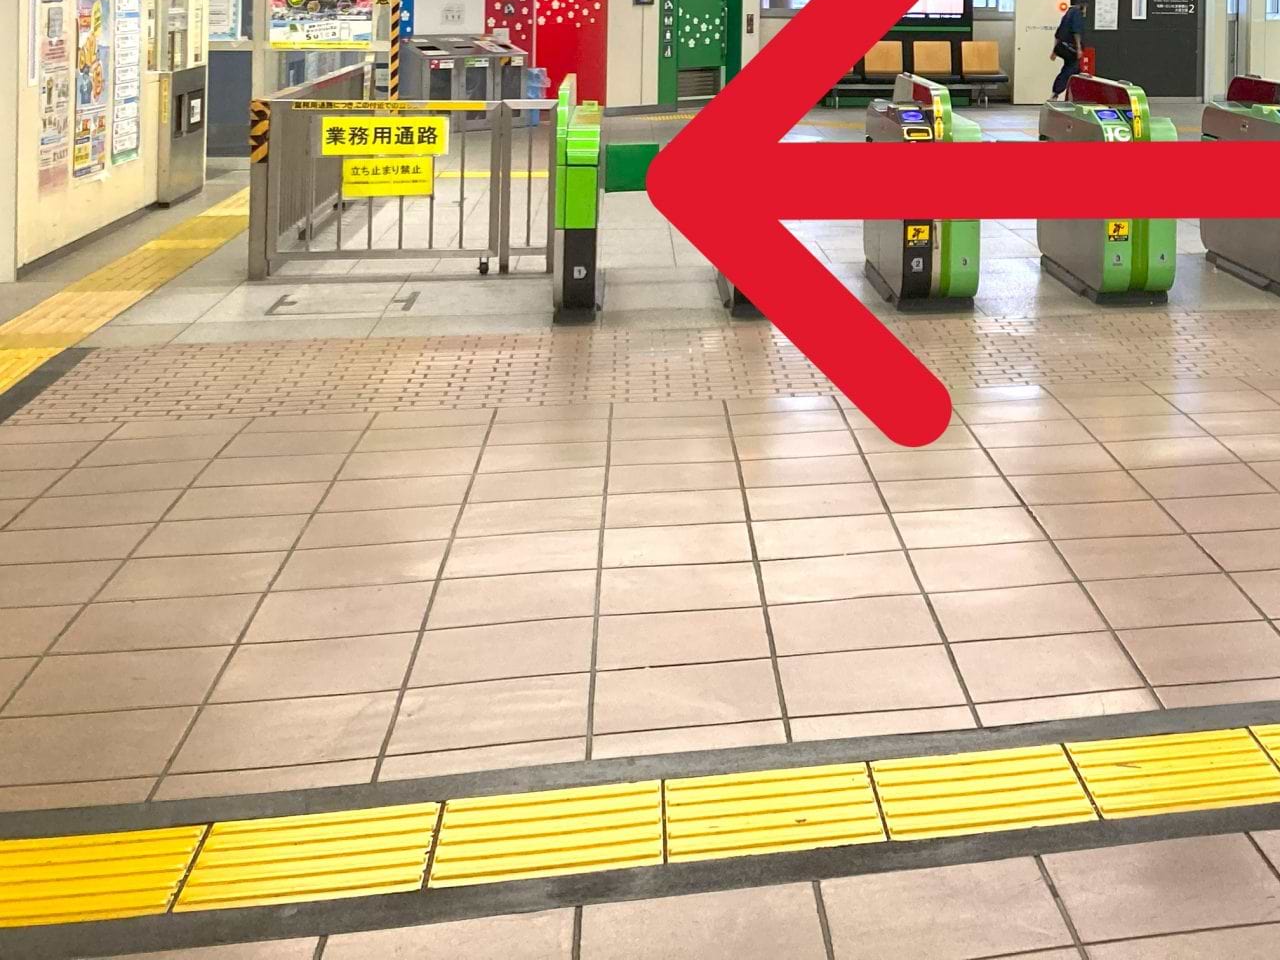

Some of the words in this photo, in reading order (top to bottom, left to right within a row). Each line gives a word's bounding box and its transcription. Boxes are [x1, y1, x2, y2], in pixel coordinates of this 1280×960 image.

[1188, 4, 1195, 14] 2
[326, 126, 438, 146] 業務用通路
[351, 165, 421, 176] 立ち止まり禁止
